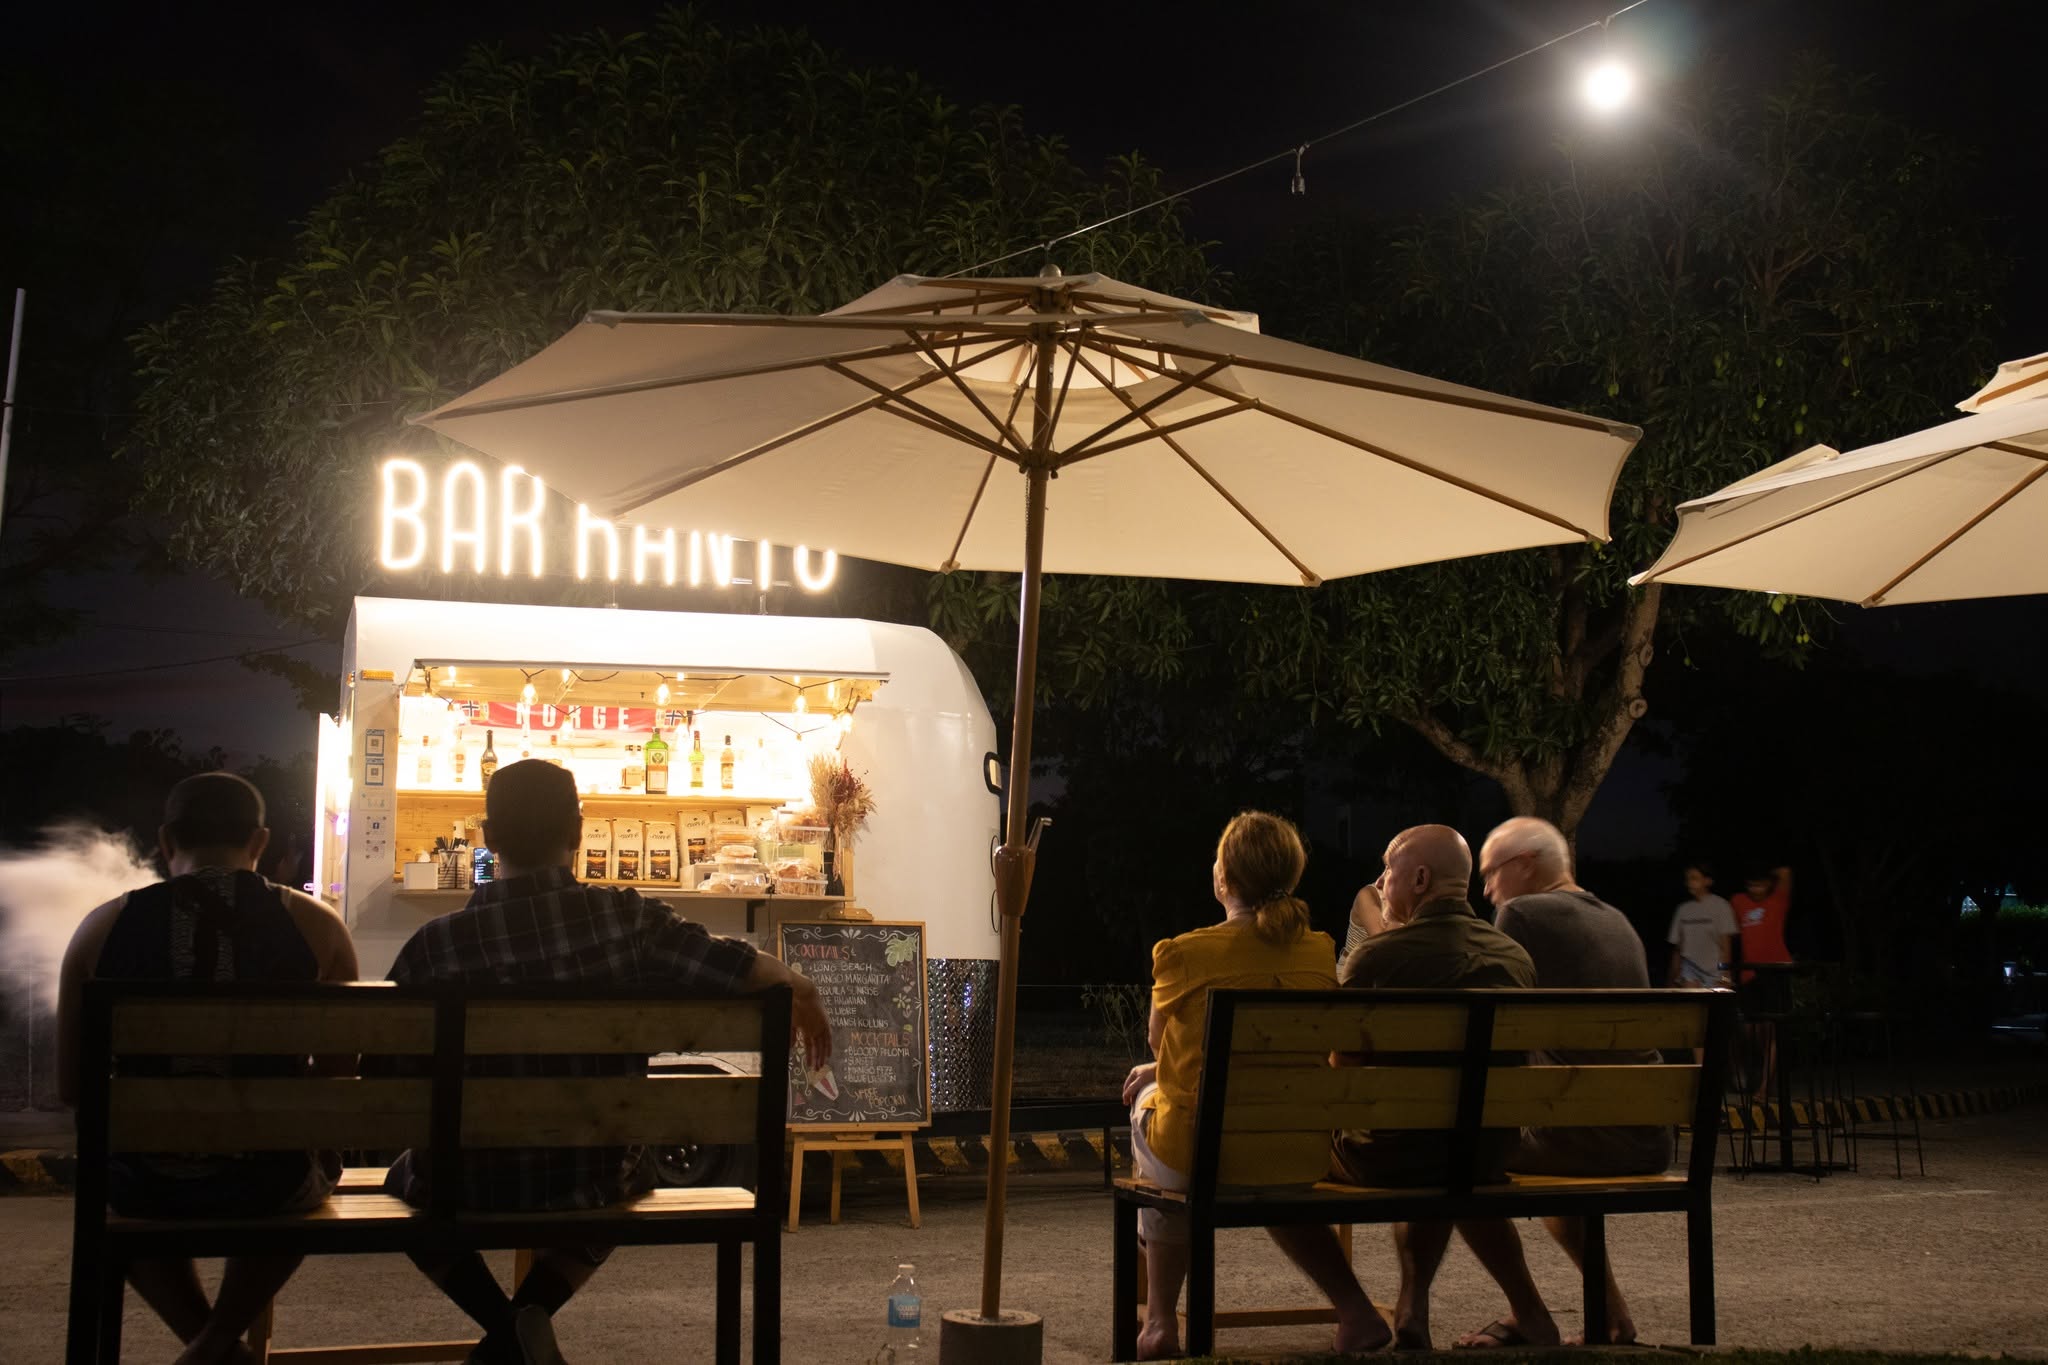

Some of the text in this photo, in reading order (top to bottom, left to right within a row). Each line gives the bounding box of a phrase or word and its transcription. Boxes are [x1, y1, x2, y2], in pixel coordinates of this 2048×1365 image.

[378, 456, 546, 578] BAR
[516, 703, 630, 731] NORGE
[813, 961, 872, 972] LONG BEACH
[811, 973, 890, 985] MANGO MARGARITA
[850, 1031, 912, 1047] MOCKTAILS
[869, 1094, 906, 1109] POPCORN
